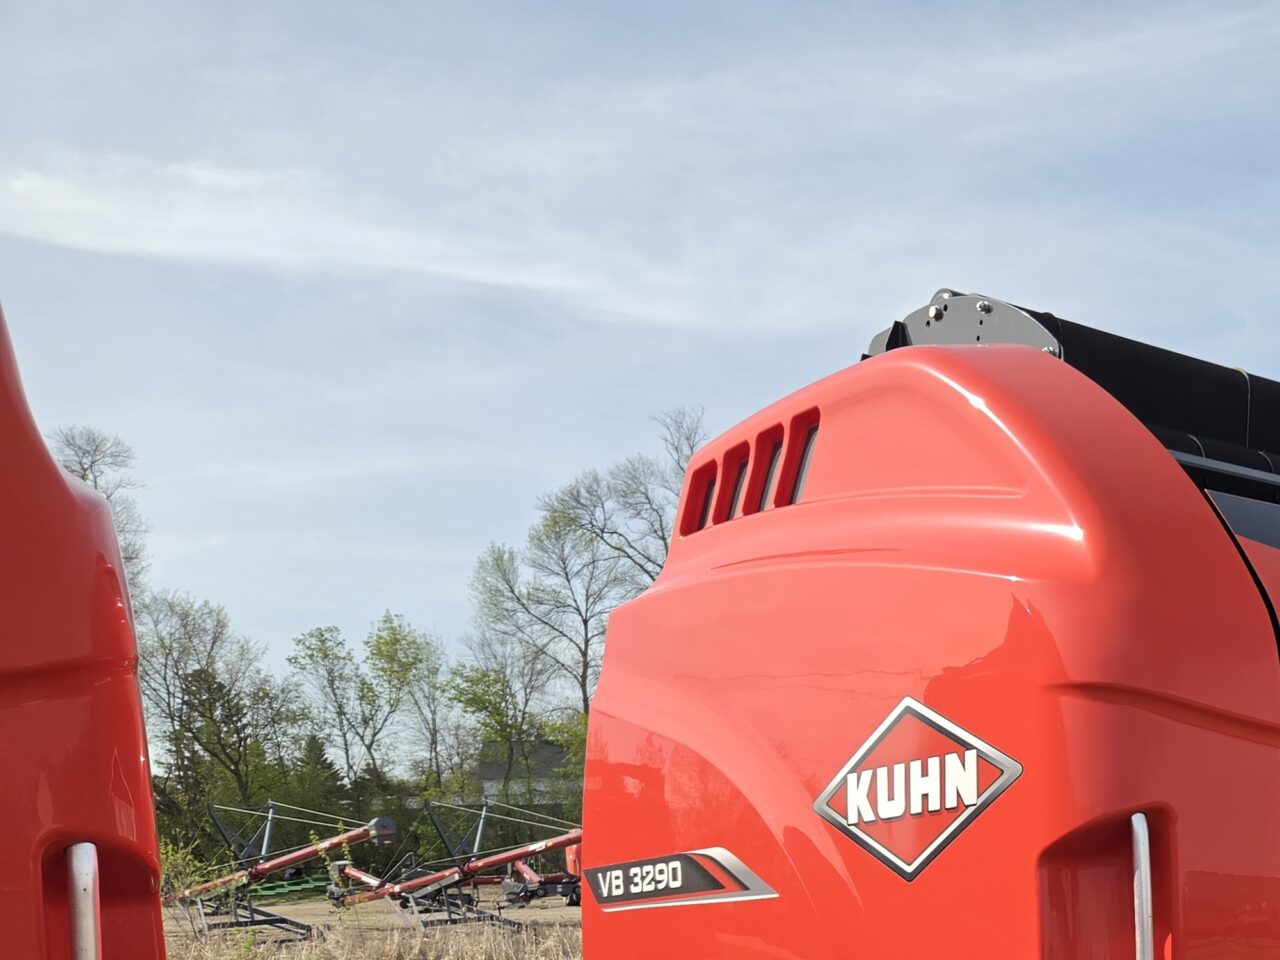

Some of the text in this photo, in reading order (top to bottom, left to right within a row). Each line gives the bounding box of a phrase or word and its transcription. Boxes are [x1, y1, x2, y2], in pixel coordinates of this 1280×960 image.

[846, 749, 979, 826] KUHN
[597, 860, 683, 898] VB 3290
